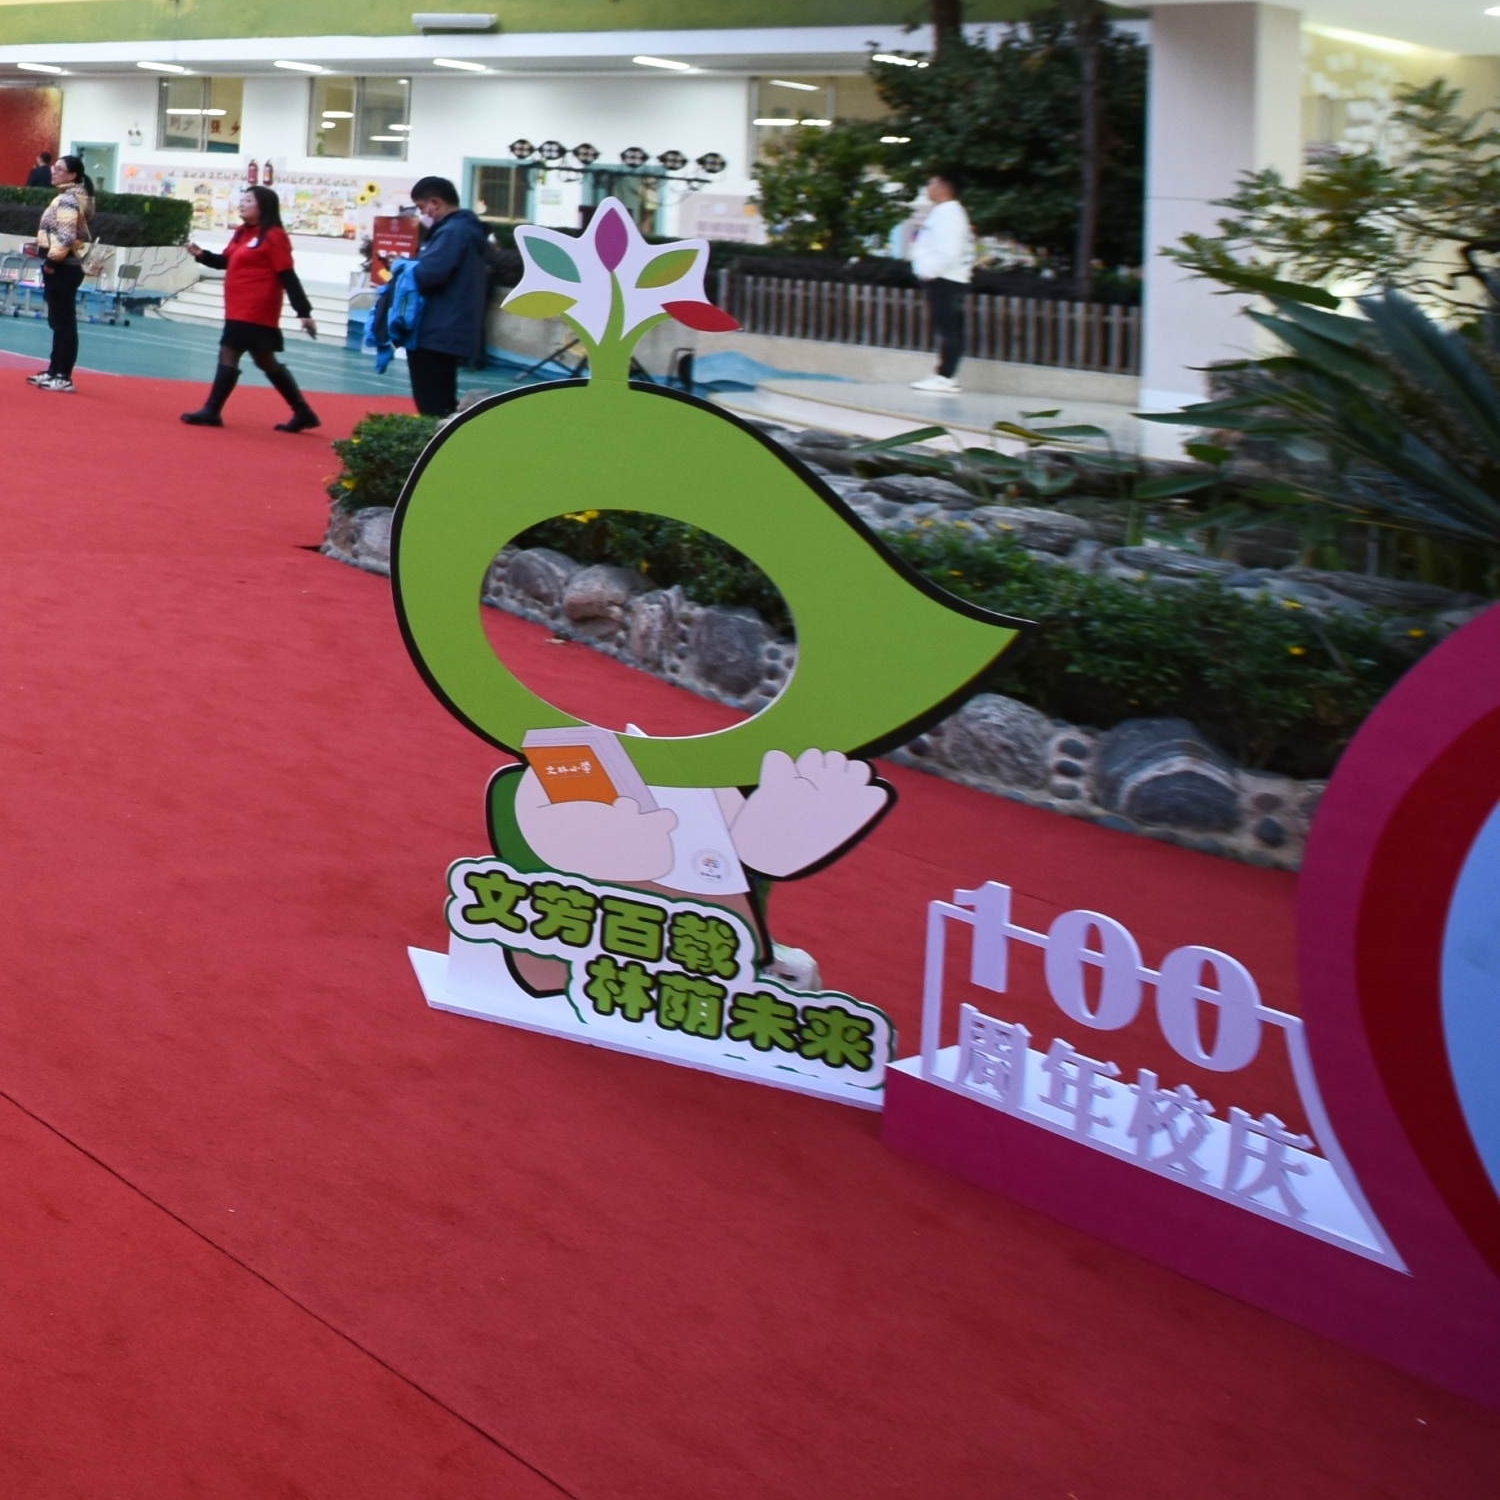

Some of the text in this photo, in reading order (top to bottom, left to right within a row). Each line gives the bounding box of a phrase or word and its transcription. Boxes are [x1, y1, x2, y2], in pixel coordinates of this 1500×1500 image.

[462, 869, 741, 980] 文芳百载
[953, 880, 1262, 1073] 100
[583, 954, 876, 1073] 林荫未来
[955, 1002, 1316, 1220] 周年校庆
